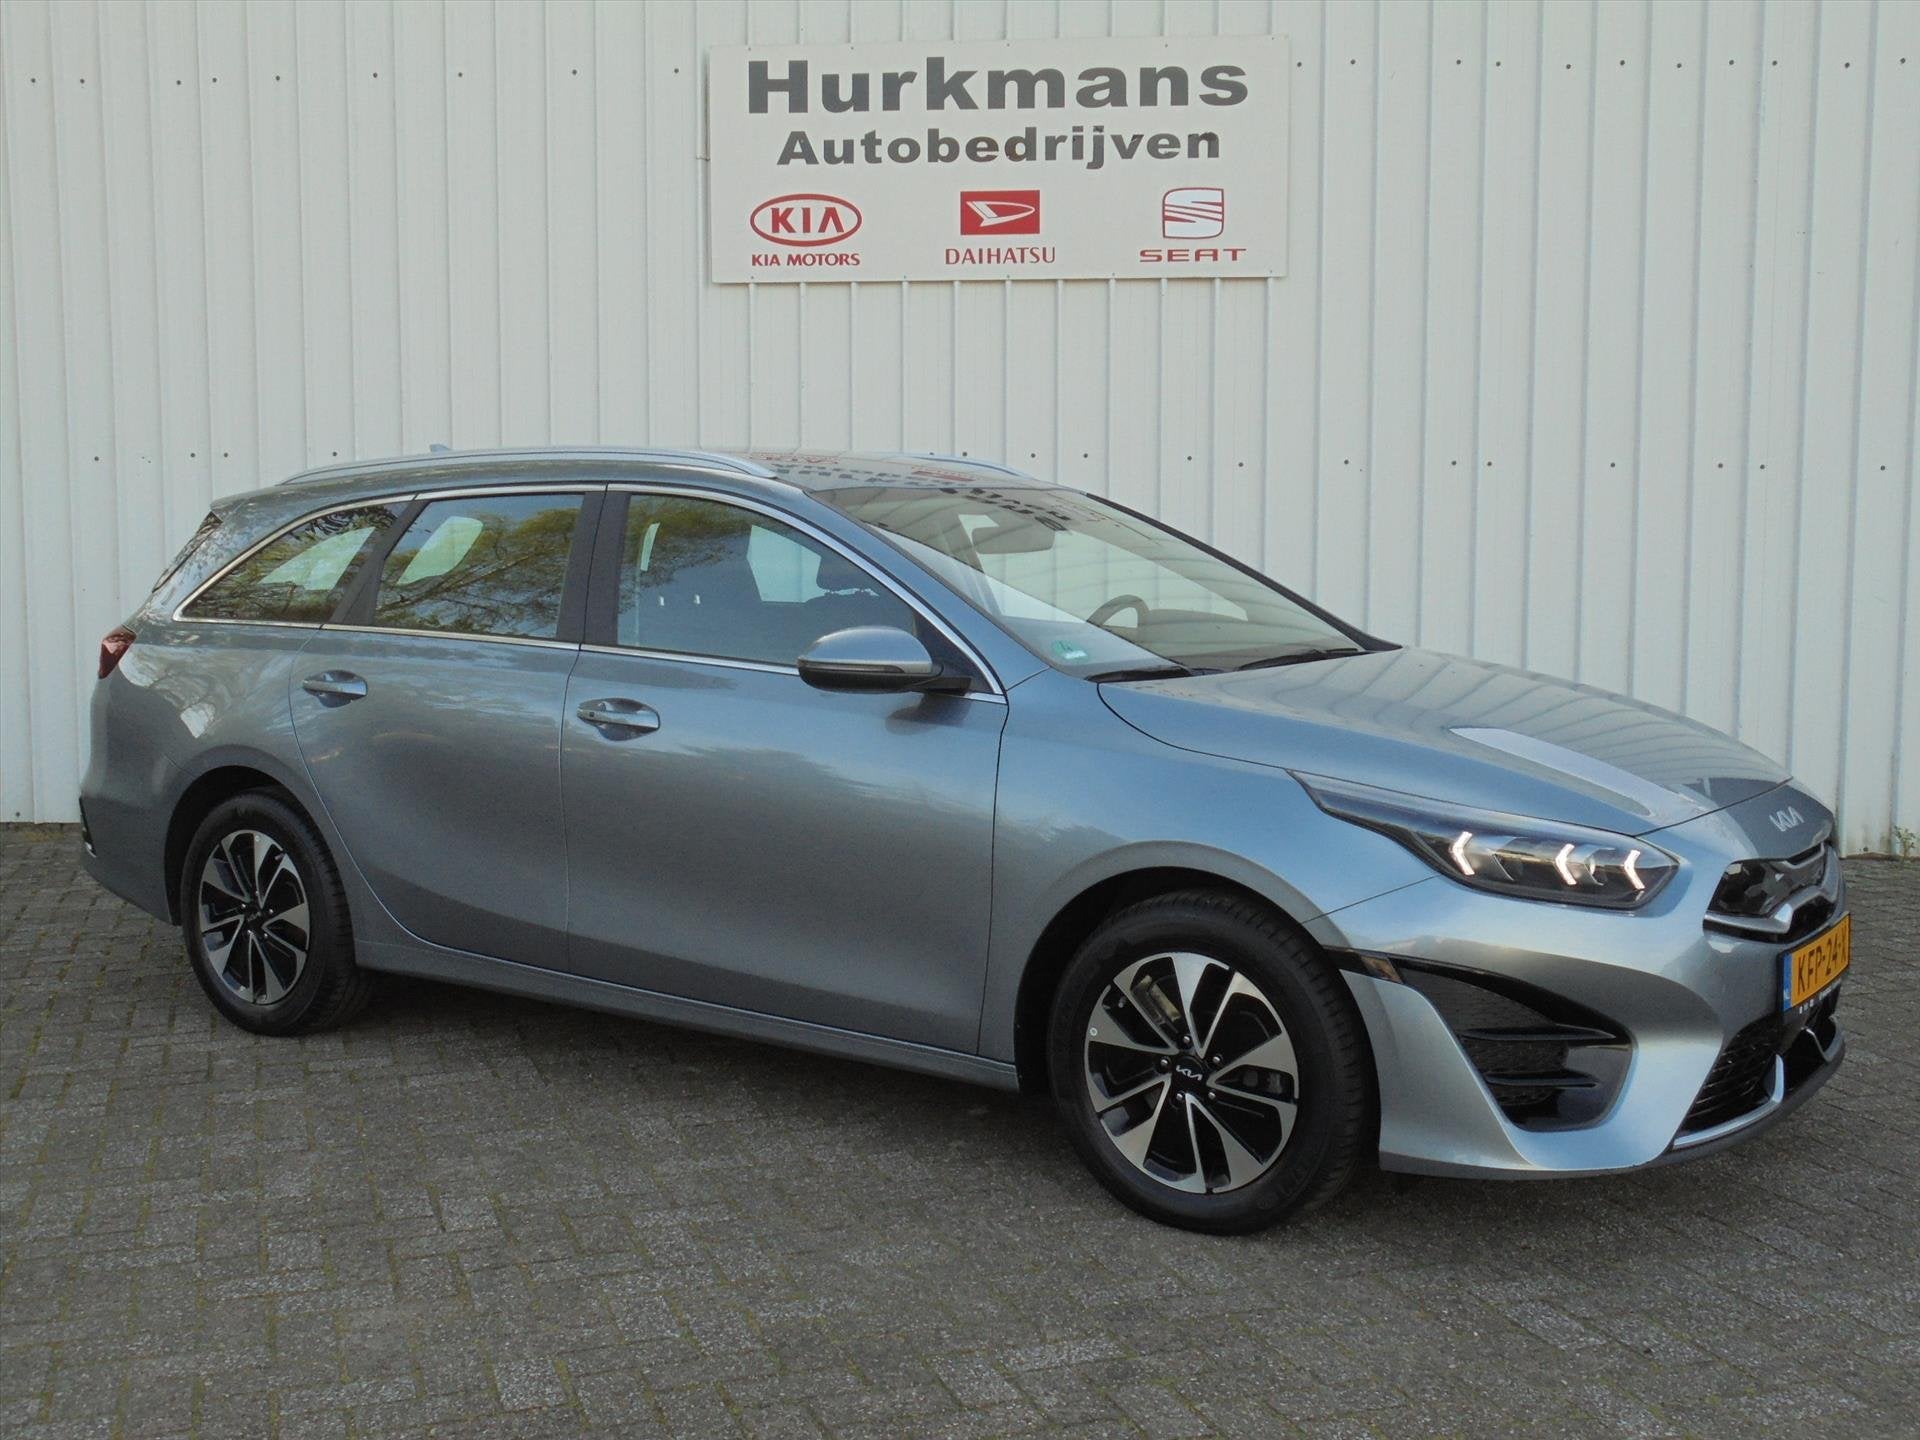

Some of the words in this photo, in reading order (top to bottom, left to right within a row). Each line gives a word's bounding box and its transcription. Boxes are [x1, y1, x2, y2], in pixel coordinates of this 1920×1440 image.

[748, 57, 1249, 114] Hurkmans
[776, 126, 1220, 170] Autobedrijven
[770, 205, 844, 234] KIA
[751, 253, 781, 266] KIA
[786, 252, 861, 267] MOTORS
[945, 247, 1057, 266] DAIHATSU
[1139, 247, 1248, 263] SEAT
